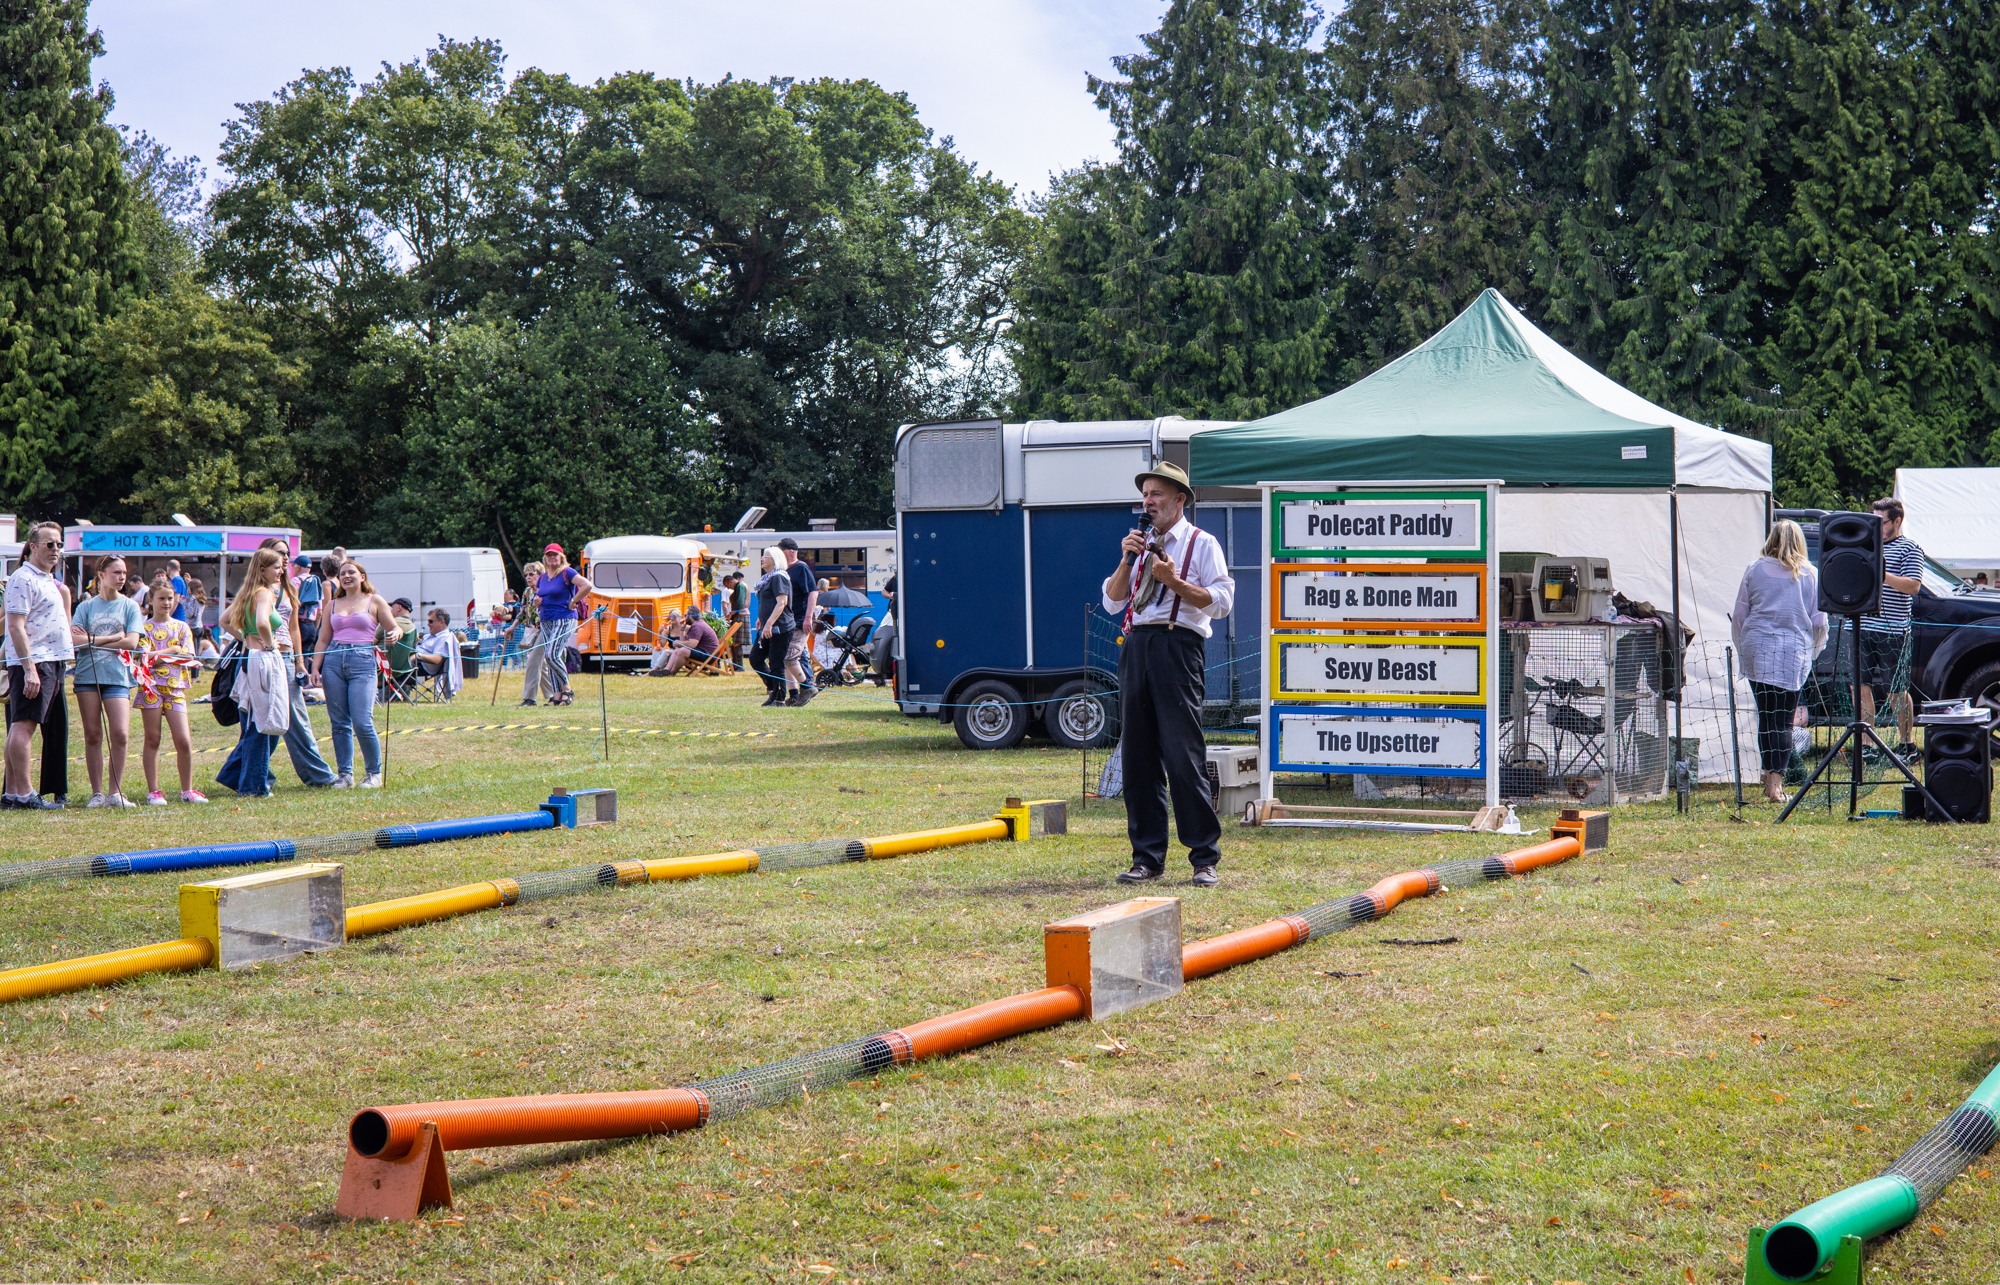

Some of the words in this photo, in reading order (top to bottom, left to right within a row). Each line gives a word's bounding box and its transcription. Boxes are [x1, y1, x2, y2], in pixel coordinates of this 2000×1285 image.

[1308, 514, 1385, 537] Polecat
[1389, 514, 1453, 538] Paddy
[85, 534, 106, 548] BURGERS
[114, 535, 139, 547] HOT
[142, 535, 151, 547] &
[155, 535, 190, 547] TASTY
[194, 534, 205, 543] HOT
[205, 538, 220, 549] DOGS
[1304, 586, 1340, 608] Rag
[1345, 588, 1359, 607] &
[1363, 586, 1411, 607] Bone
[1416, 586, 1458, 608] Man
[1325, 657, 1373, 683] Sexy
[1378, 659, 1437, 681] Beast
[1317, 730, 1352, 752] The
[1357, 731, 1440, 755] Upsetter
